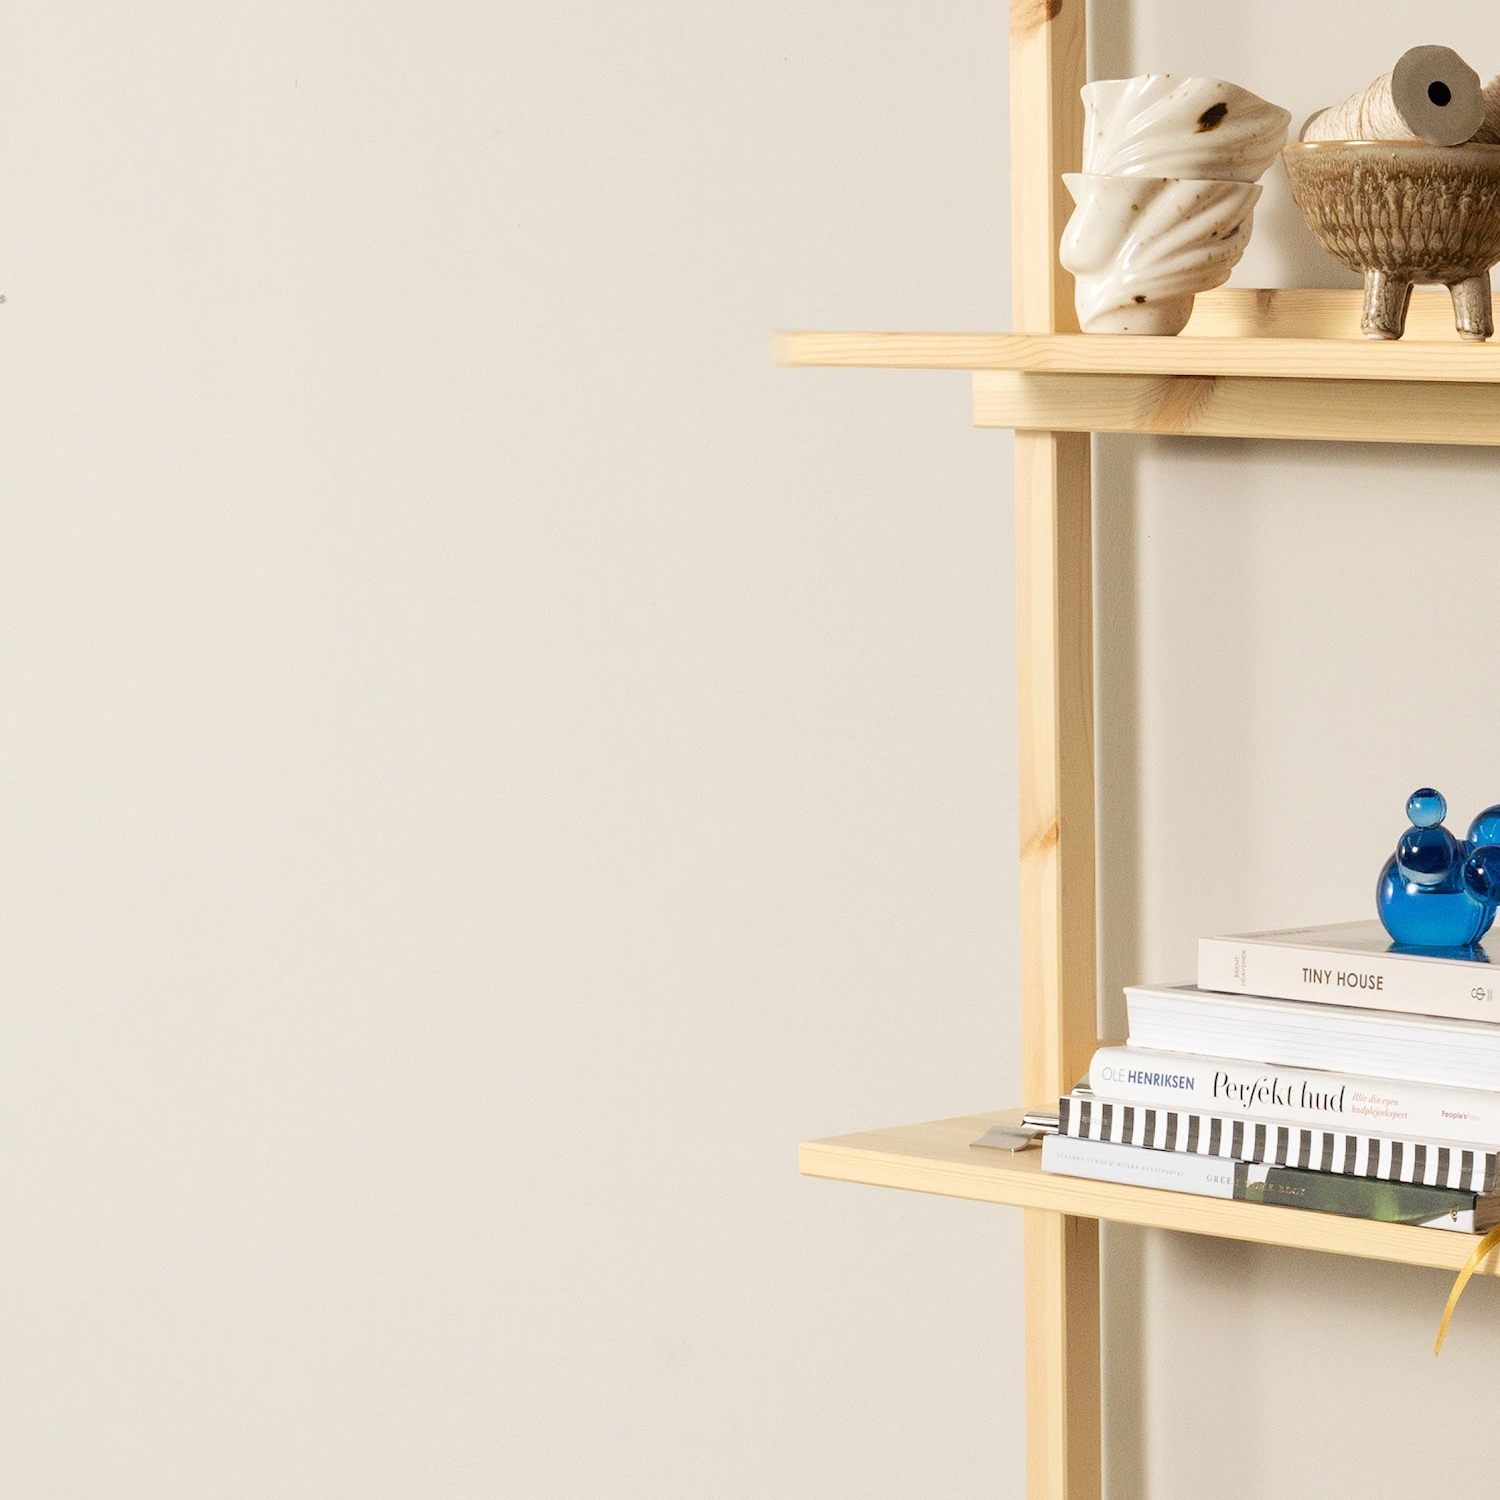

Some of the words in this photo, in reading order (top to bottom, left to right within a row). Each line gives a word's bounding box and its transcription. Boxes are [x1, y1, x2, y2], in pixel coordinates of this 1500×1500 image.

[1302, 967, 1332, 985] TINY
[1337, 971, 1383, 990] HOUSE
[1102, 1066, 1125, 1083] OLE
[1128, 1069, 1195, 1091] HENRIKSEN
[1300, 1080, 1345, 1113] hud
